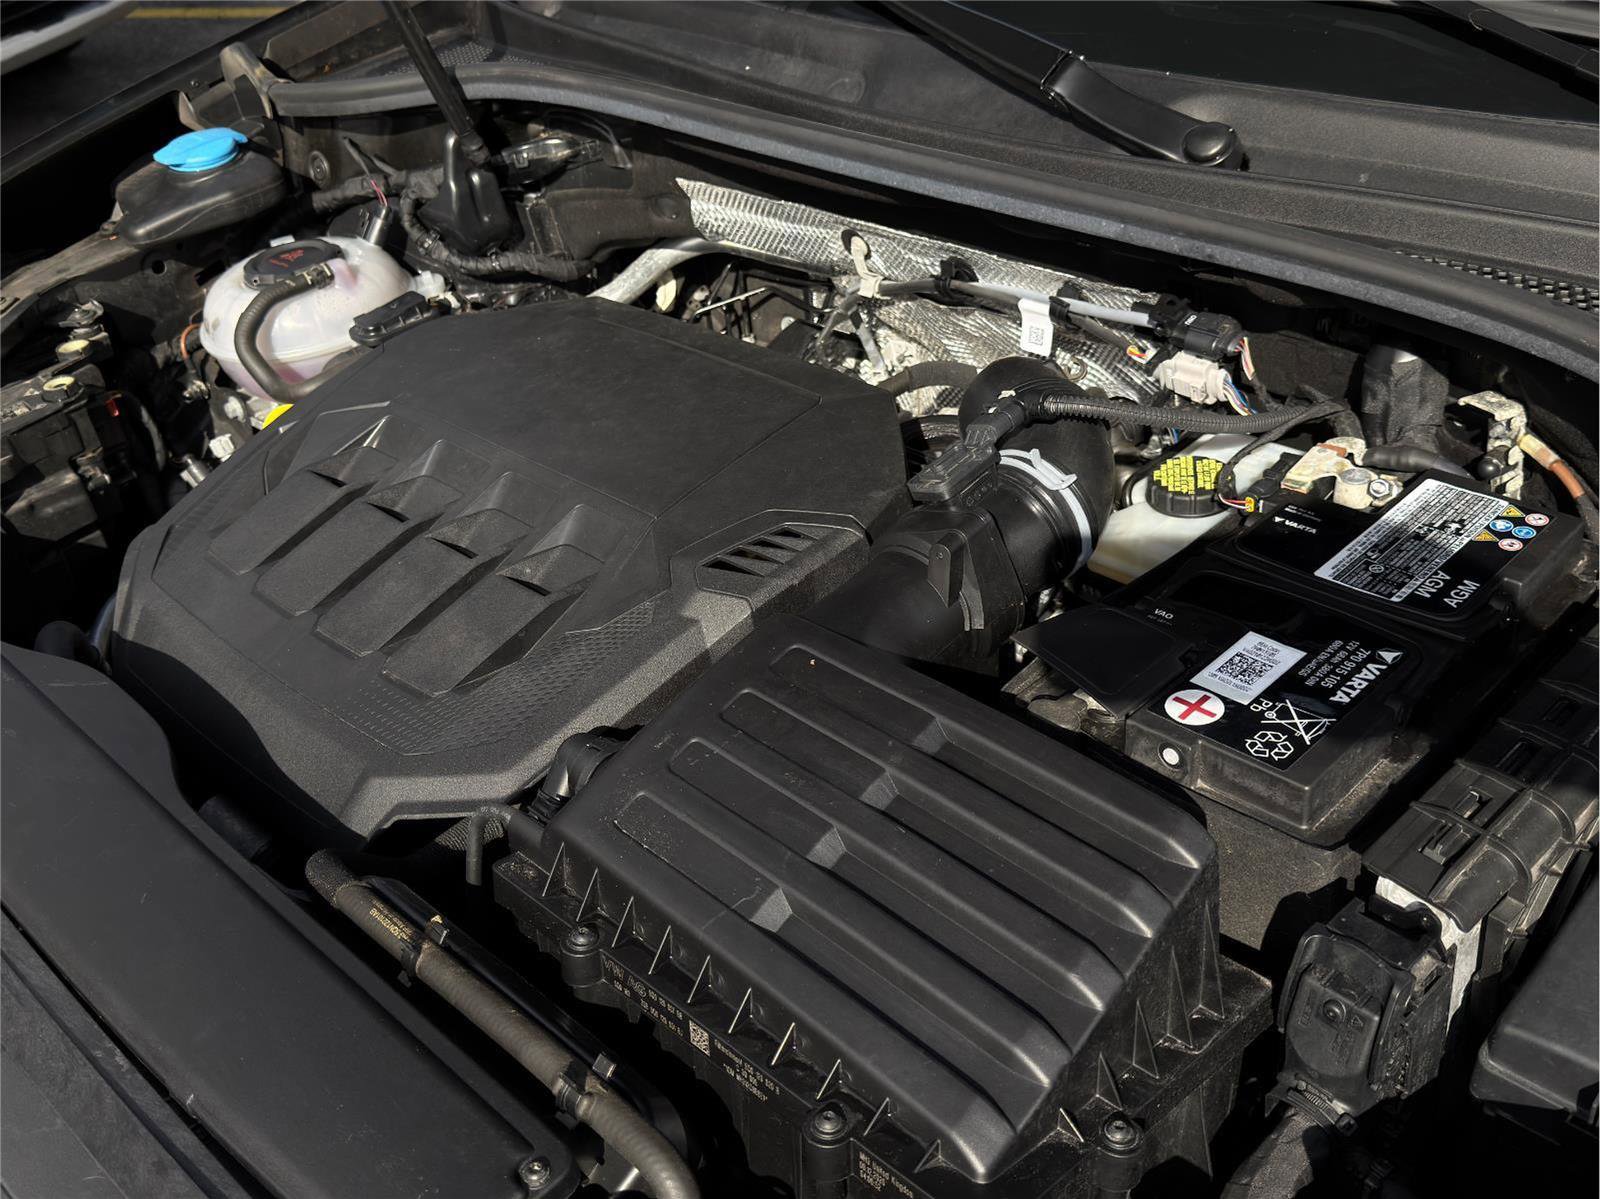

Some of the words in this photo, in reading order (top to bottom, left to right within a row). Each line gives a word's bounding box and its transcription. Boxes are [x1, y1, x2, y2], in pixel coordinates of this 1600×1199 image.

[1285, 519, 1317, 534] VARTA
[1414, 570, 1452, 598] AGM
[1443, 579, 1480, 608] AGM
[1349, 648, 1371, 663] 7P0
[1335, 660, 1357, 676] 915
[1320, 674, 1341, 689] 105
[1328, 662, 1388, 704] VARTA
[1250, 697, 1273, 712] Pb
